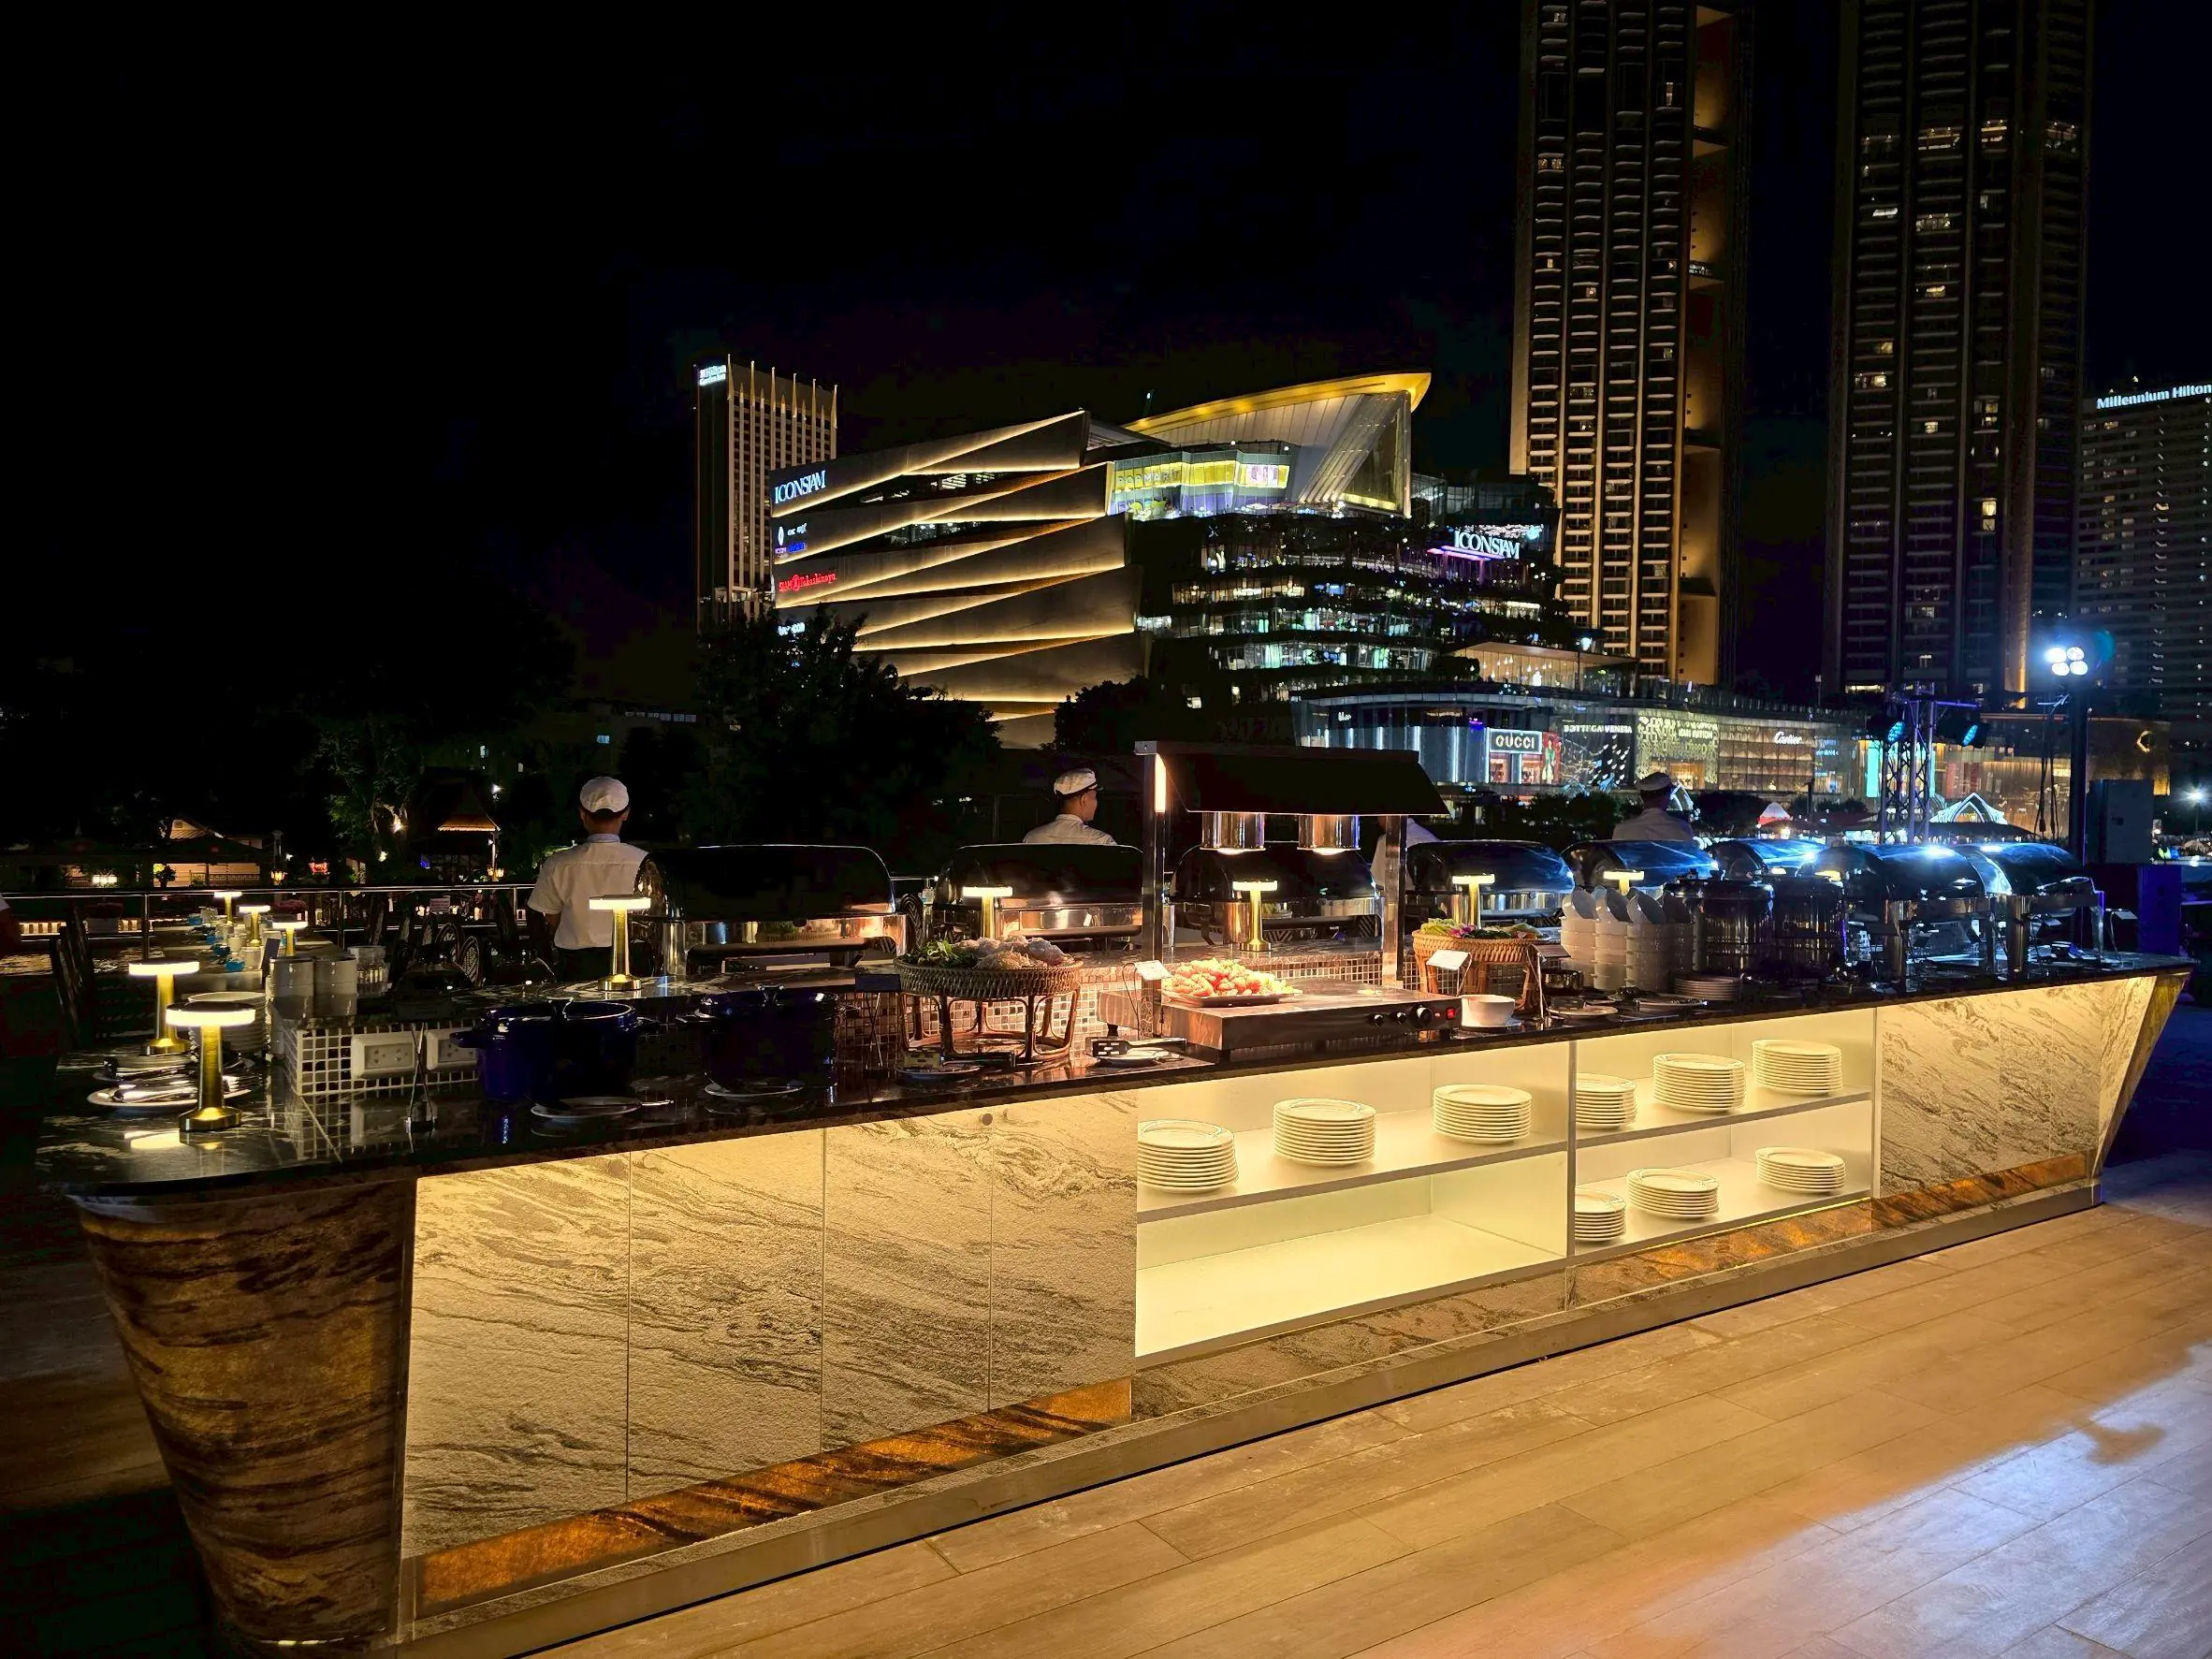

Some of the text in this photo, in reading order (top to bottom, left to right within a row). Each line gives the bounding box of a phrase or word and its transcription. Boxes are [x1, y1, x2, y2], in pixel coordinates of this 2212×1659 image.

[2097, 384, 2212, 409] Millennium Hilton
[775, 470, 826, 504] ICONSIAM
[1454, 530, 1520, 560] ICONSIAM
[1495, 735, 1535, 749] GUCCI
[1774, 730, 1804, 745] Cartier
